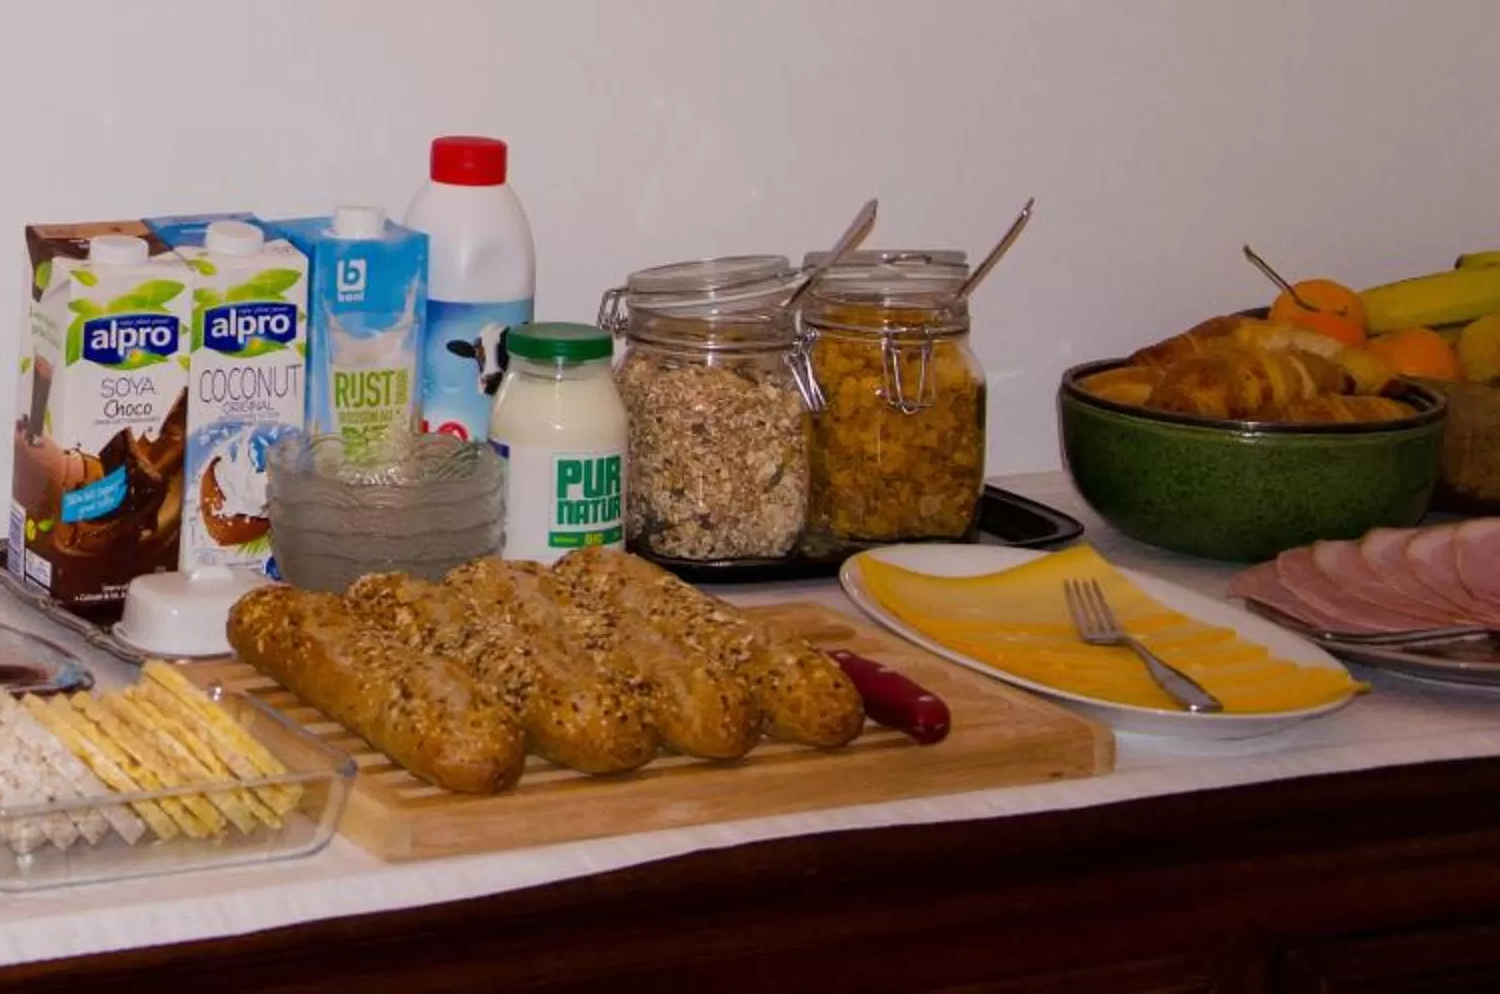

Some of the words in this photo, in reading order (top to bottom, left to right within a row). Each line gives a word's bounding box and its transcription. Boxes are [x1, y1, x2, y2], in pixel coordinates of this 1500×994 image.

[91, 319, 172, 357] alpro
[211, 307, 291, 344] alpro
[100, 377, 157, 398] SOYA
[200, 364, 302, 403] COCONUT
[557, 455, 621, 499] PUR
